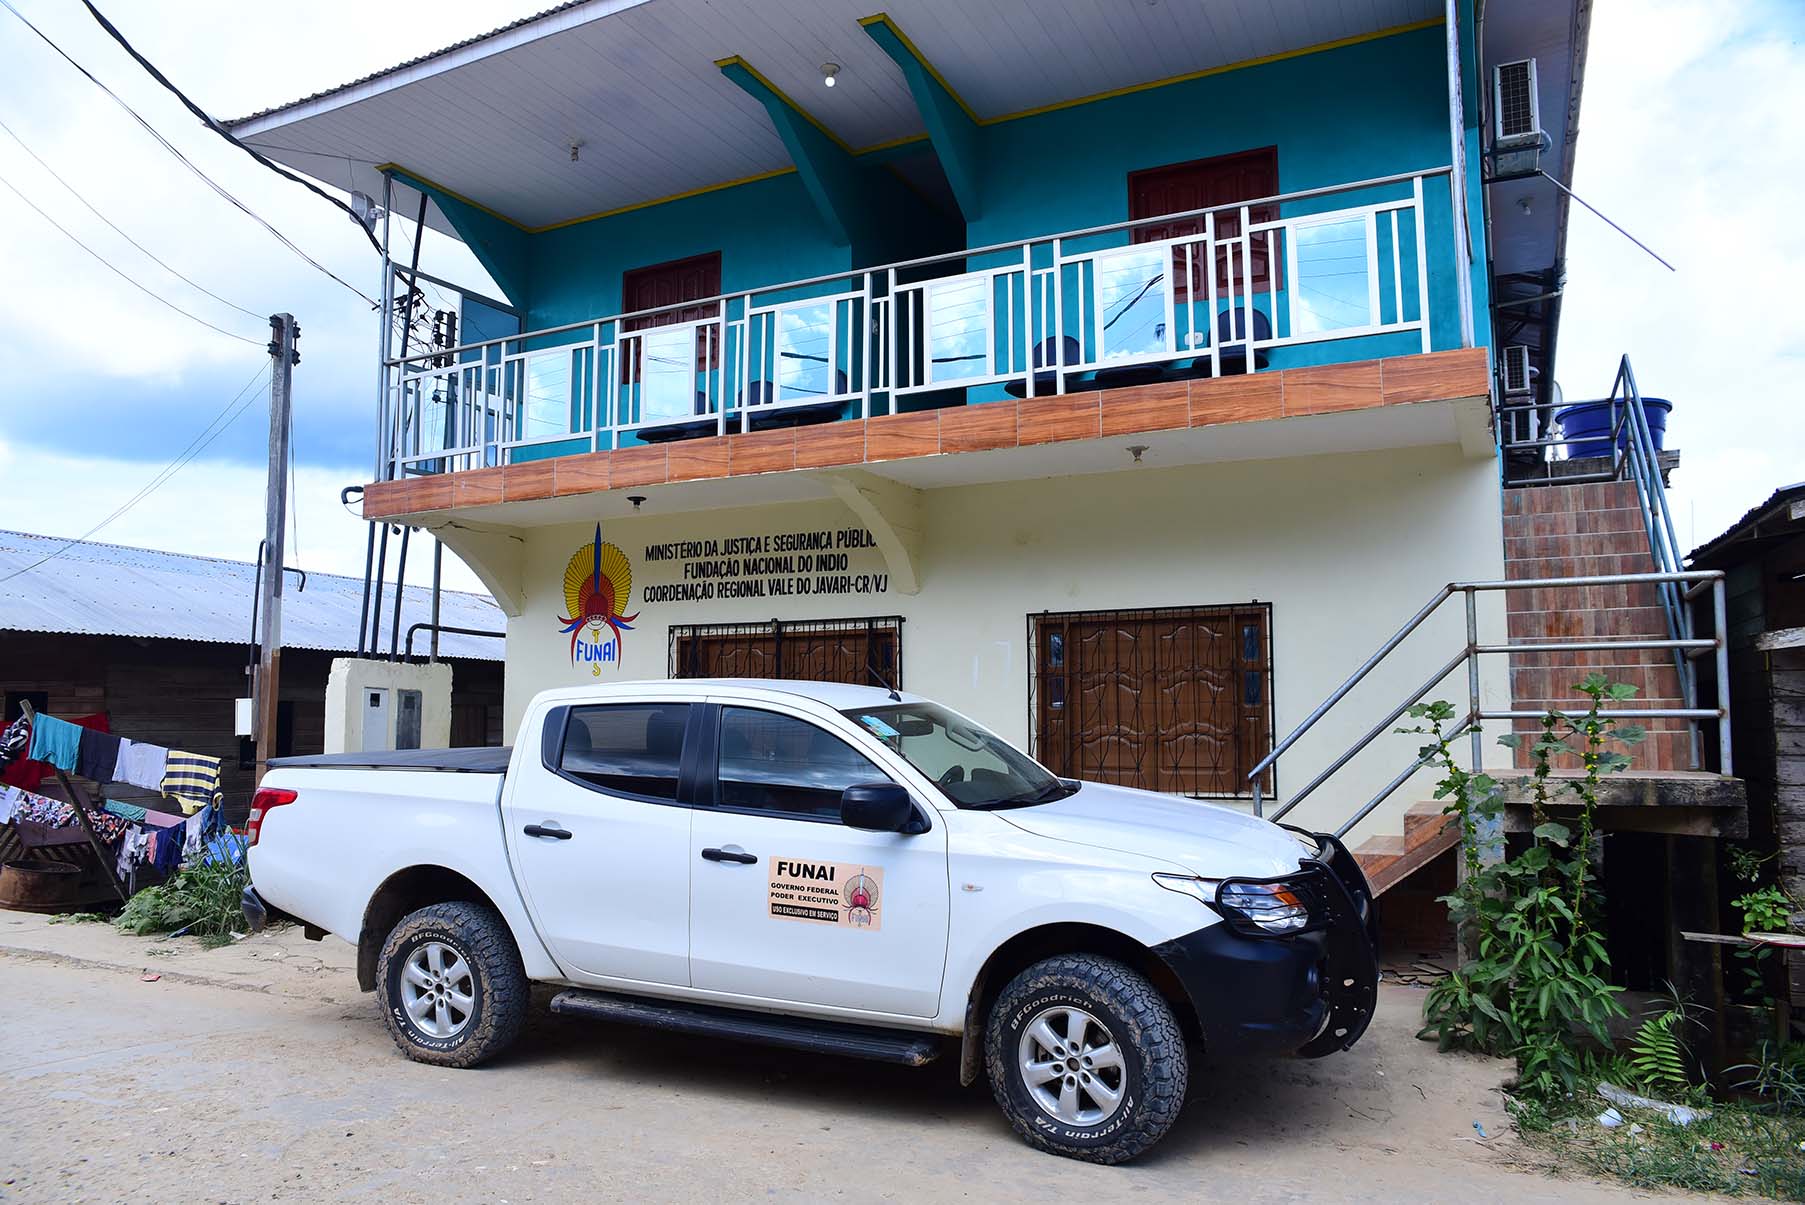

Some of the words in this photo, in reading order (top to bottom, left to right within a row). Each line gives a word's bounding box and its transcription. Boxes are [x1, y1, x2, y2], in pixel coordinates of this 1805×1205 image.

[645, 540, 702, 562] MINISTÉRIO
[704, 540, 718, 557] DA
[720, 536, 762, 556] JUSTIÇA
[764, 535, 771, 553] E
[773, 531, 832, 552] SEGURANÇA
[684, 558, 739, 579] FUNDAÇÃO
[743, 556, 795, 576] NACIONAL
[798, 555, 813, 573] DO
[815, 553, 848, 572] INDIO
[643, 580, 714, 603] COORDENAÇÃO
[717, 579, 766, 598] REGIONAL
[768, 578, 794, 597] VALE
[796, 577, 811, 595] DO
[576, 638, 616, 662] FUNAI
[777, 861, 835, 881] FUNAI
[771, 882, 805, 892] GOVERNO
[806, 886, 839, 895] FEDERAL
[771, 892, 794, 900] PODER
[798, 895, 839, 905] EXECUTIVO
[772, 905, 783, 913] USO
[783, 906, 809, 917] EXCLUSIVO
[411, 931, 472, 964] BFGoodrich
[1011, 994, 1092, 1030] BFGoodrich
